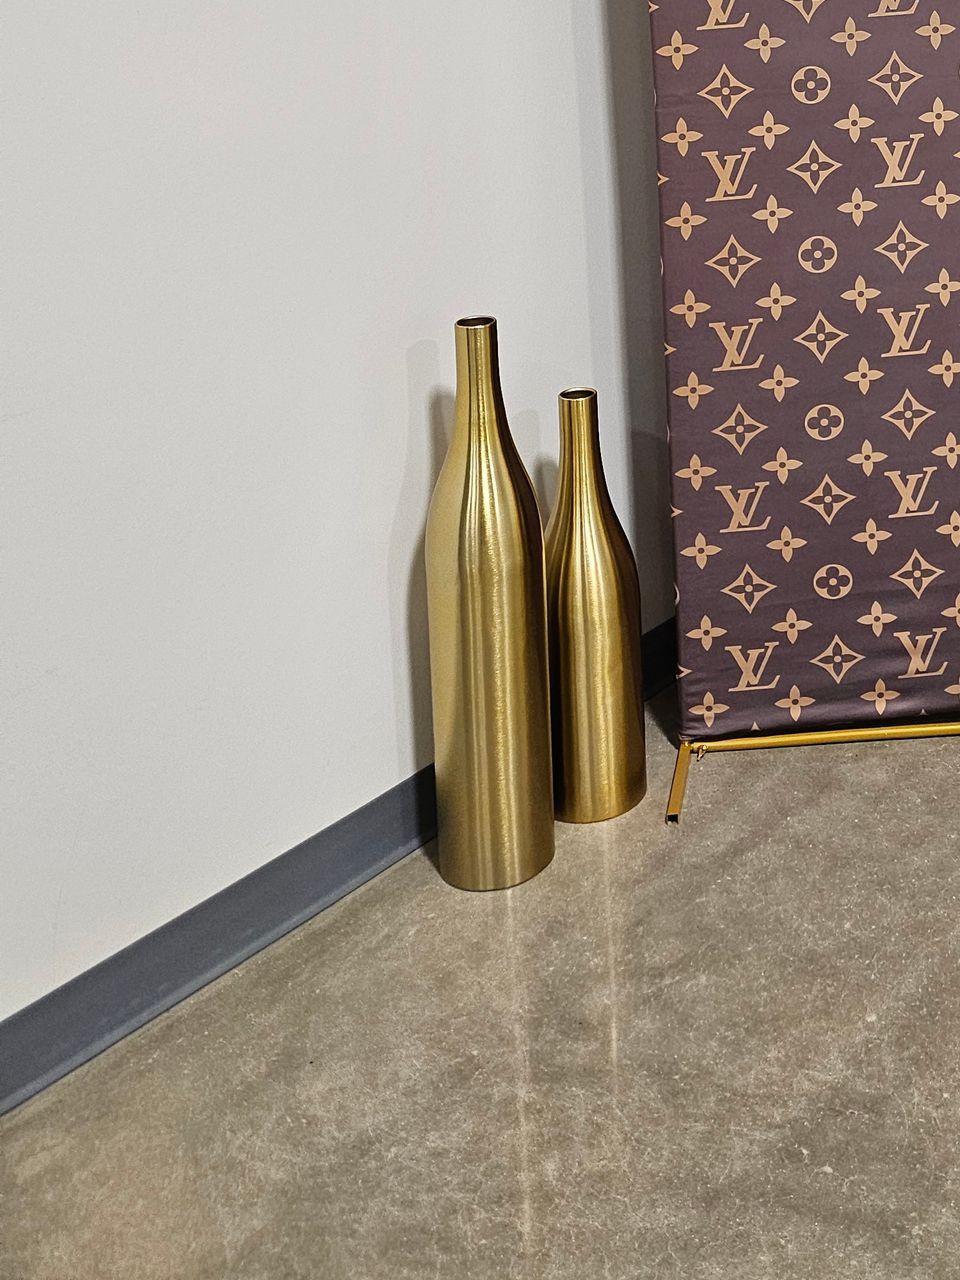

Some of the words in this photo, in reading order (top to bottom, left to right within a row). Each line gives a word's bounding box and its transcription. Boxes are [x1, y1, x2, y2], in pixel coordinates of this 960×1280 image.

[701, 147, 758, 203] LV
[870, 133, 925, 188] LV
[708, 318, 764, 372] LV
[876, 304, 931, 358] LV
[714, 481, 772, 534] LV
[883, 466, 938, 519] LV
[724, 642, 780, 693] LV
[893, 627, 948, 680] LV
